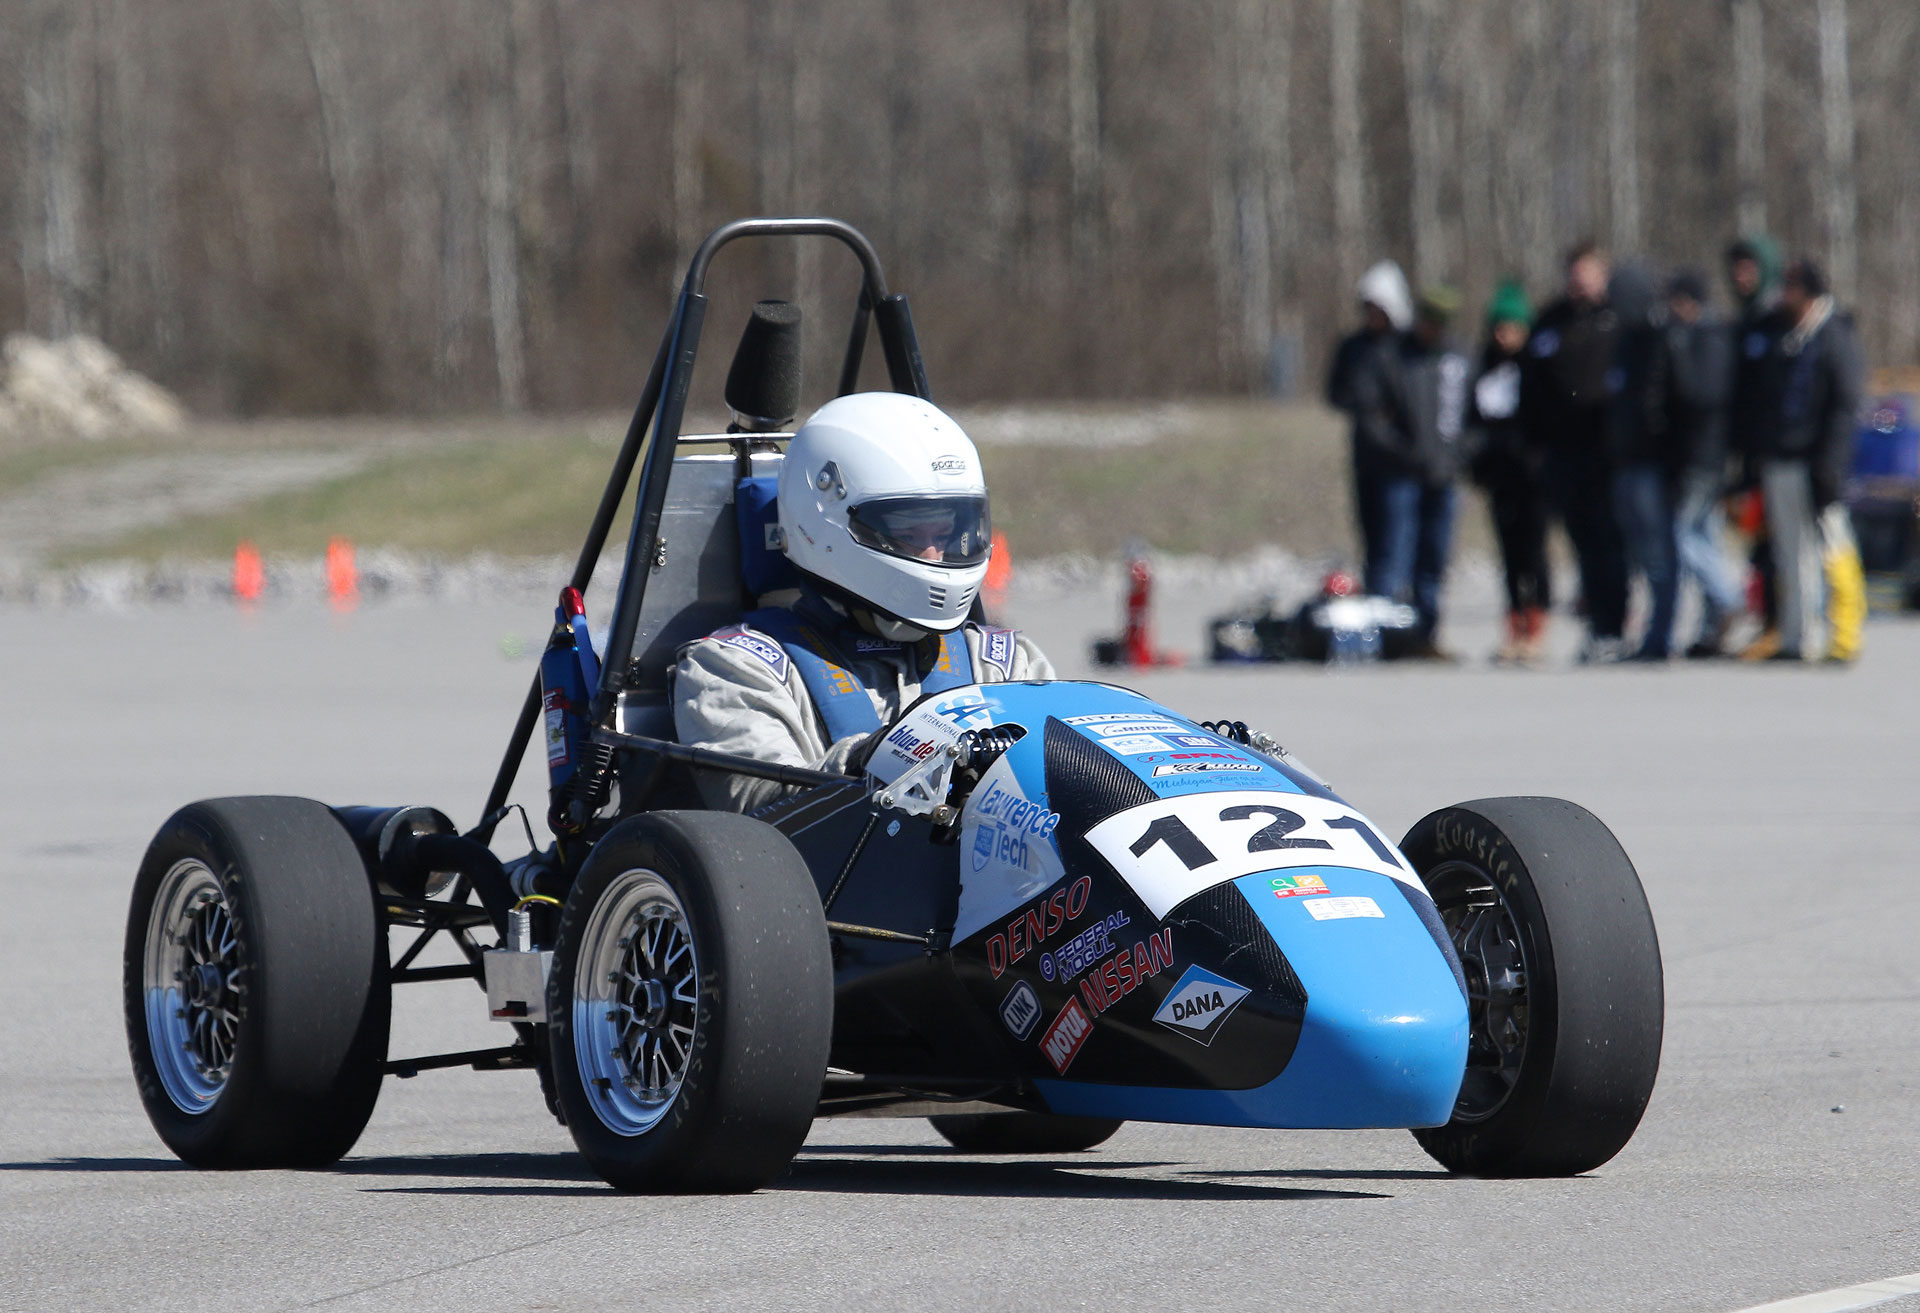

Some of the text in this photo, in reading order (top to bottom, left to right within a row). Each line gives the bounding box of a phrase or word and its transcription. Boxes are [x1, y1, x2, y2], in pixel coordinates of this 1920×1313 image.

[887, 725, 920, 751] blue
[921, 712, 961, 739] INTERNATIONAL
[976, 779, 1060, 840] Lawrence
[1128, 804, 1405, 871] 121
[995, 821, 1028, 870] Tech
[1434, 813, 1518, 890] Hoosier
[985, 875, 1092, 981] DENSO
[1055, 910, 1131, 968] FEDERAL
[1059, 935, 1116, 985] MOGUL
[1079, 927, 1174, 1019] NISSAN
[1006, 990, 1035, 1031] LINK
[1171, 990, 1225, 1022] DANA
[1044, 1005, 1089, 1069] MOTUL
